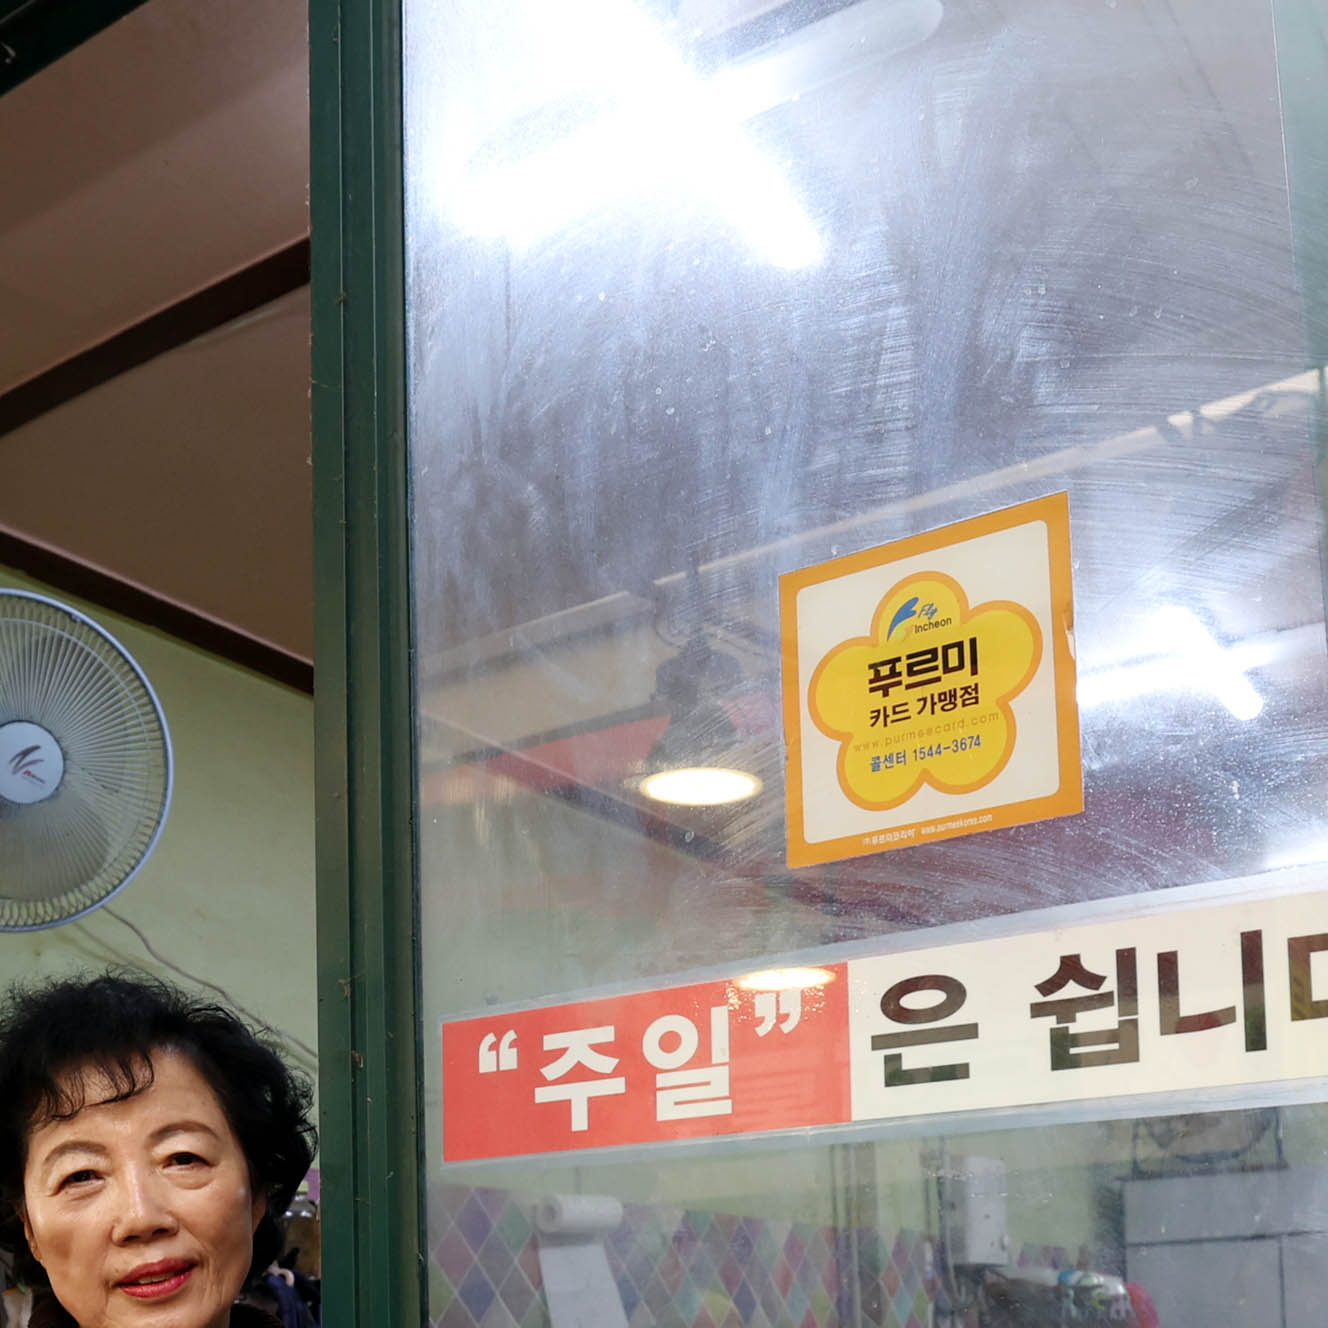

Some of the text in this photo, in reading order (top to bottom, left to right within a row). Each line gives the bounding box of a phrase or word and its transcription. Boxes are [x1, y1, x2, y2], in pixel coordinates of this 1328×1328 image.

[914, 617, 952, 634] Incheon
[868, 636, 979, 698] 푸르미
[869, 682, 980, 728] 카드 가맹점
[870, 734, 982, 773] 콜센터 1544-3674
[871, 974, 979, 1088] 은
